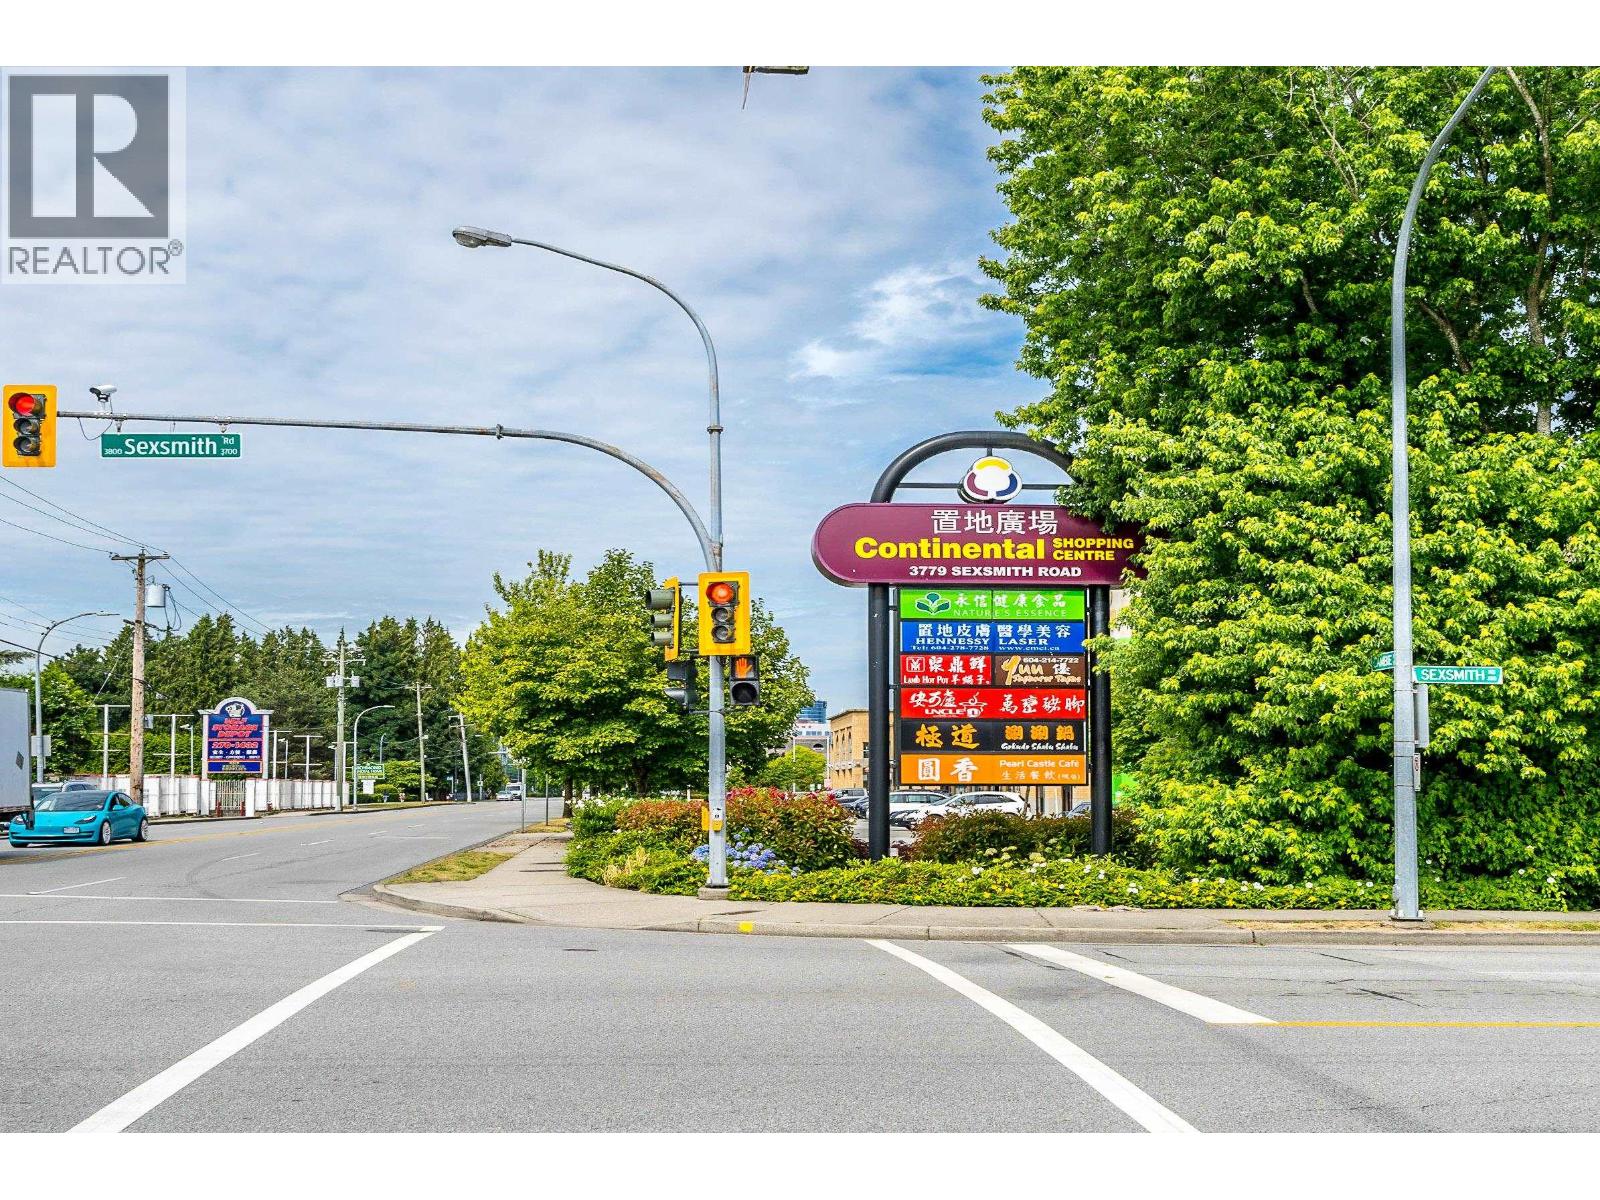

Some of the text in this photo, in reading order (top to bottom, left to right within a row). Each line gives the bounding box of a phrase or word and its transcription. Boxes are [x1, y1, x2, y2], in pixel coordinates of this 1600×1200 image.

[124, 437, 235, 455] Sexsmith Rd
[931, 509, 1059, 535] 置地廣場
[854, 536, 1045, 560] Continental
[1052, 537, 1134, 550] SHOPPING
[1052, 550, 1115, 561] CENTRE
[909, 566, 1082, 577] 3779 SEXSMITH ROAD
[954, 593, 1067, 609] 永信健康食品
[1016, 609, 1067, 617] ESSENCE
[918, 623, 1071, 638] 置地皮膚 醫學美容
[1420, 668, 1486, 681] SEXSMITH
[915, 722, 980, 749] 極道
[917, 757, 979, 782] 圓香
[999, 759, 1025, 768] Pearl
[1026, 759, 1056, 768] Castle
